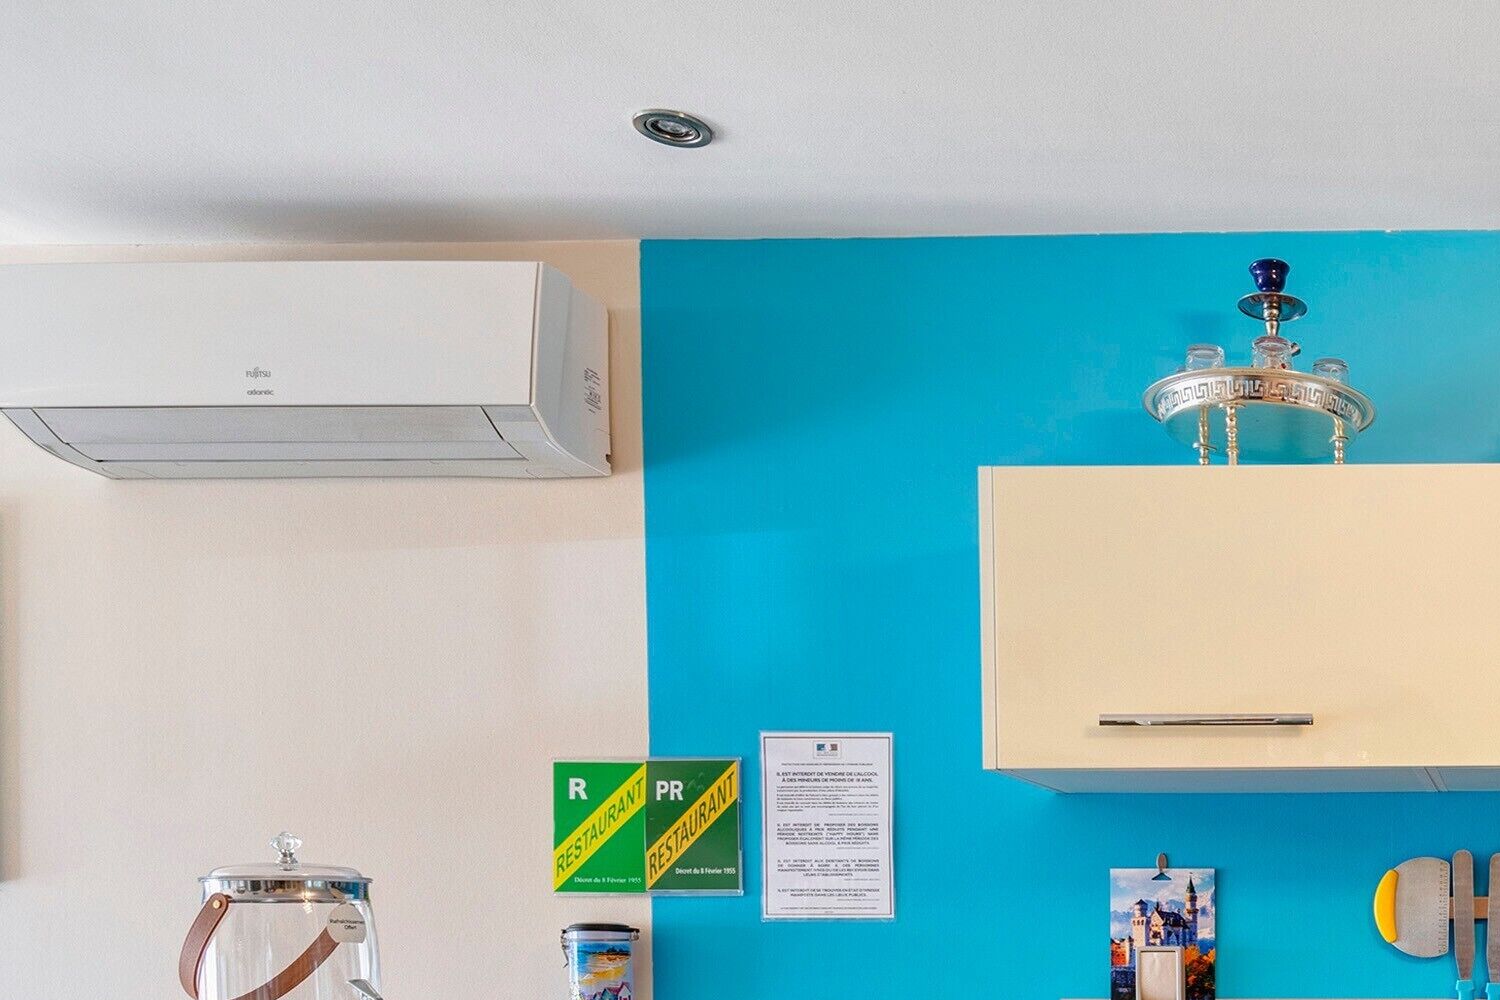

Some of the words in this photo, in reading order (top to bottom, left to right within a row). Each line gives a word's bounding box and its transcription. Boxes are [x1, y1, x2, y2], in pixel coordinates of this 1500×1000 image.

[569, 778, 588, 800] R
[656, 781, 684, 801] PR
[556, 777, 644, 878] RESTAURANT
[649, 771, 735, 879] RESTAURANT
